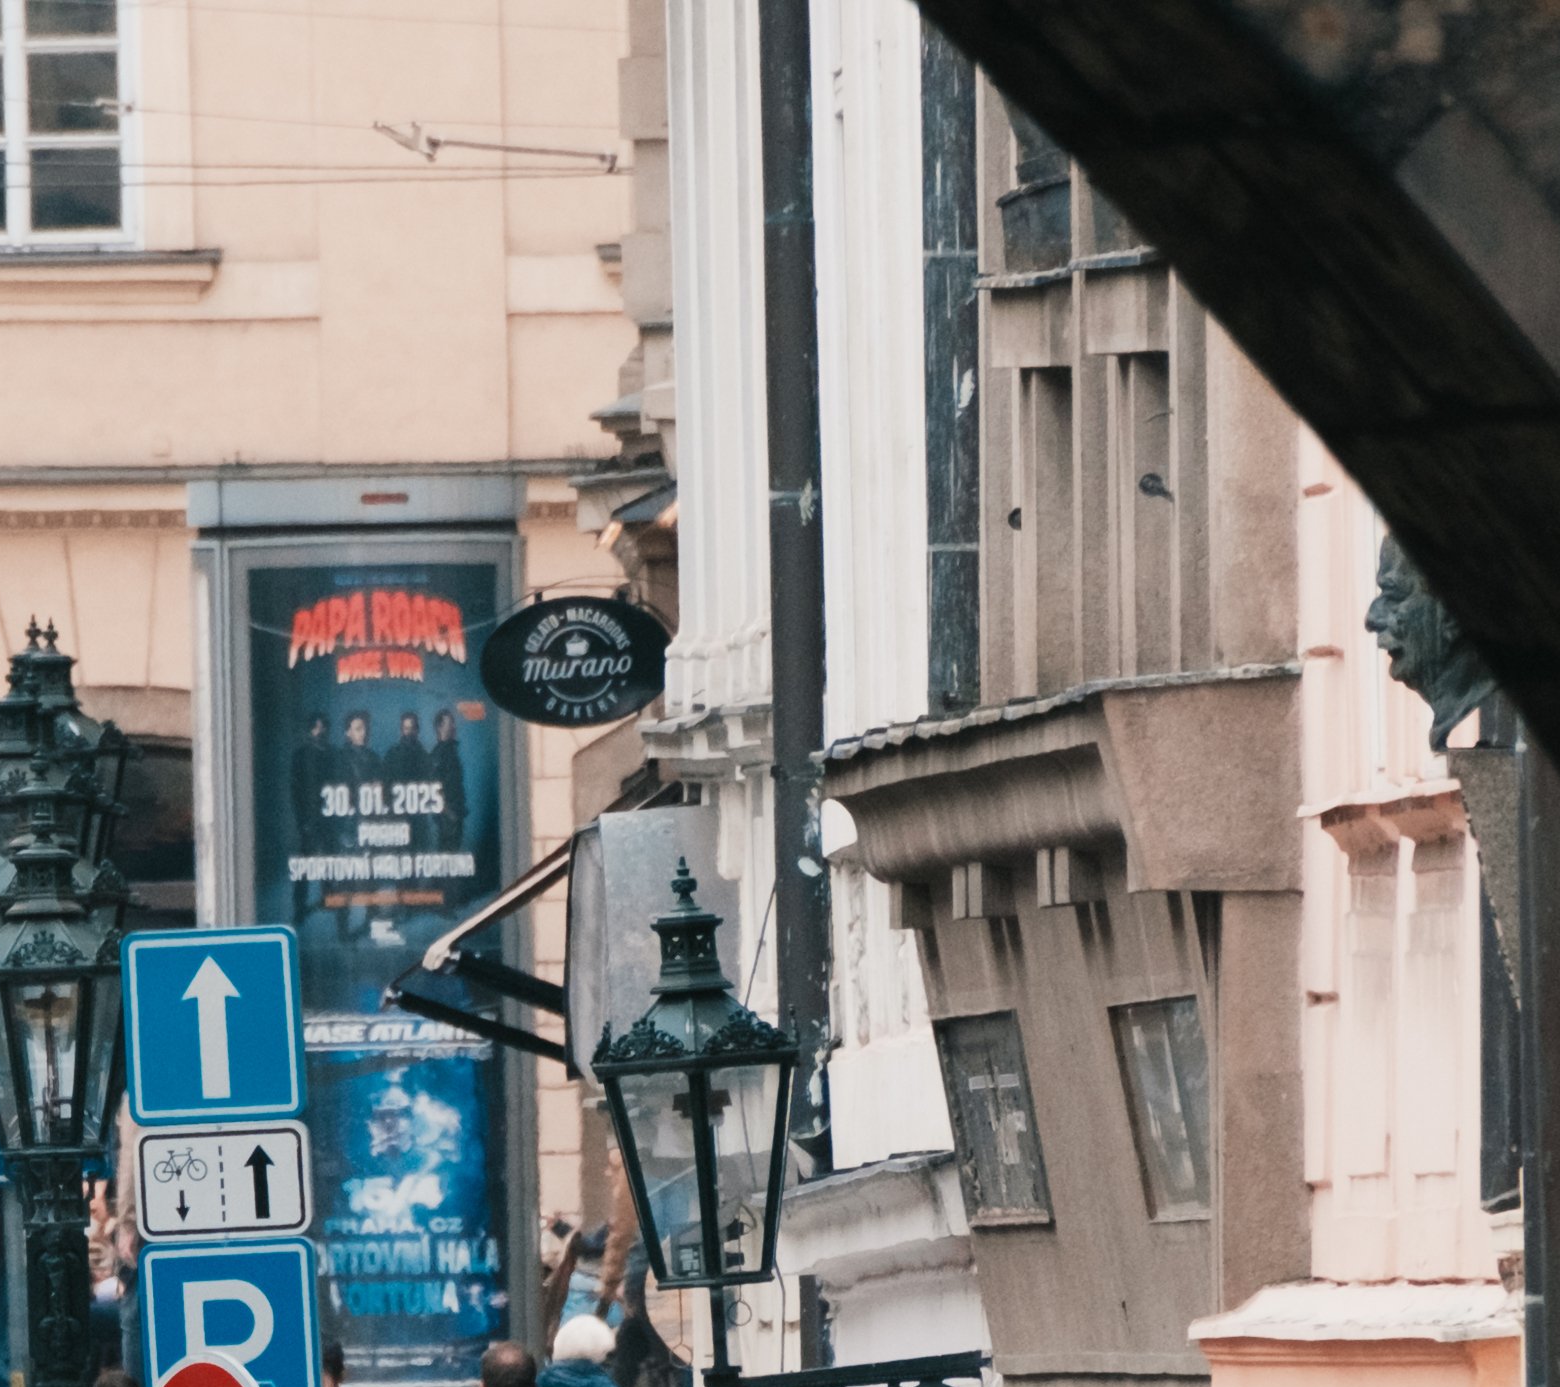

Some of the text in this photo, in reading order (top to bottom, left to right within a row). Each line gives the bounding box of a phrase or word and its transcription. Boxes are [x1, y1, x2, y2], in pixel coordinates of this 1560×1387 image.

[288, 591, 366, 669] PAPA
[524, 614, 561, 654] GELATO
[544, 690, 618, 719] BAKERY
[321, 785, 356, 817] 30.
[392, 782, 445, 815] 2025
